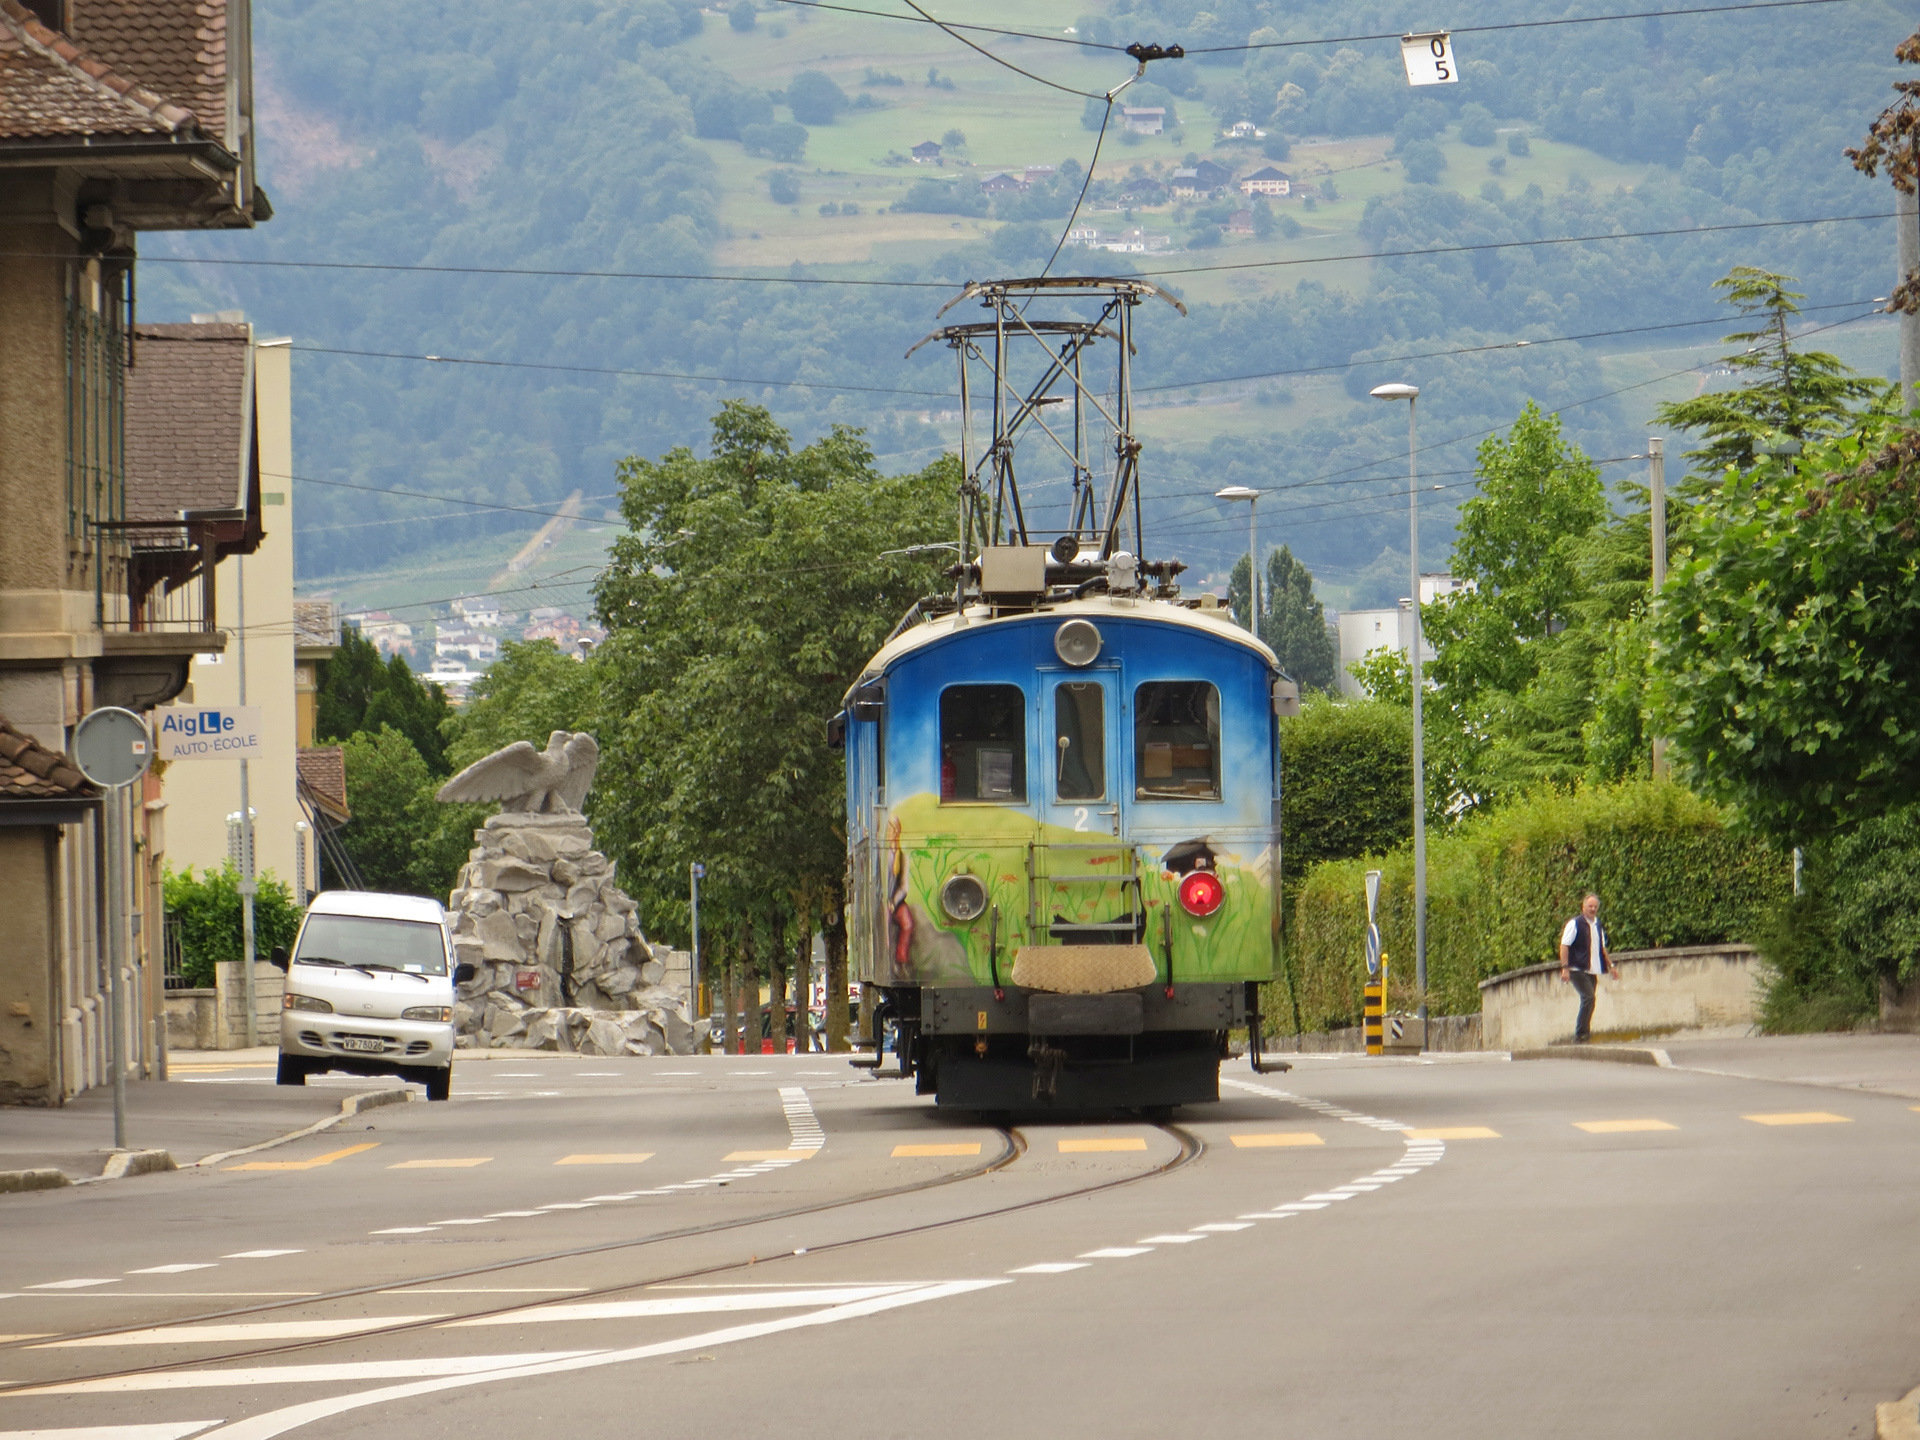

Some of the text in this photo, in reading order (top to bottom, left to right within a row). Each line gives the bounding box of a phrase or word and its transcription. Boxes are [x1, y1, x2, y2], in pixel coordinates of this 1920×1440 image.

[1431, 38, 1445, 58] 0
[1435, 60, 1450, 80] 5
[162, 711, 235, 737] AigLe
[1074, 807, 1089, 833] 2
